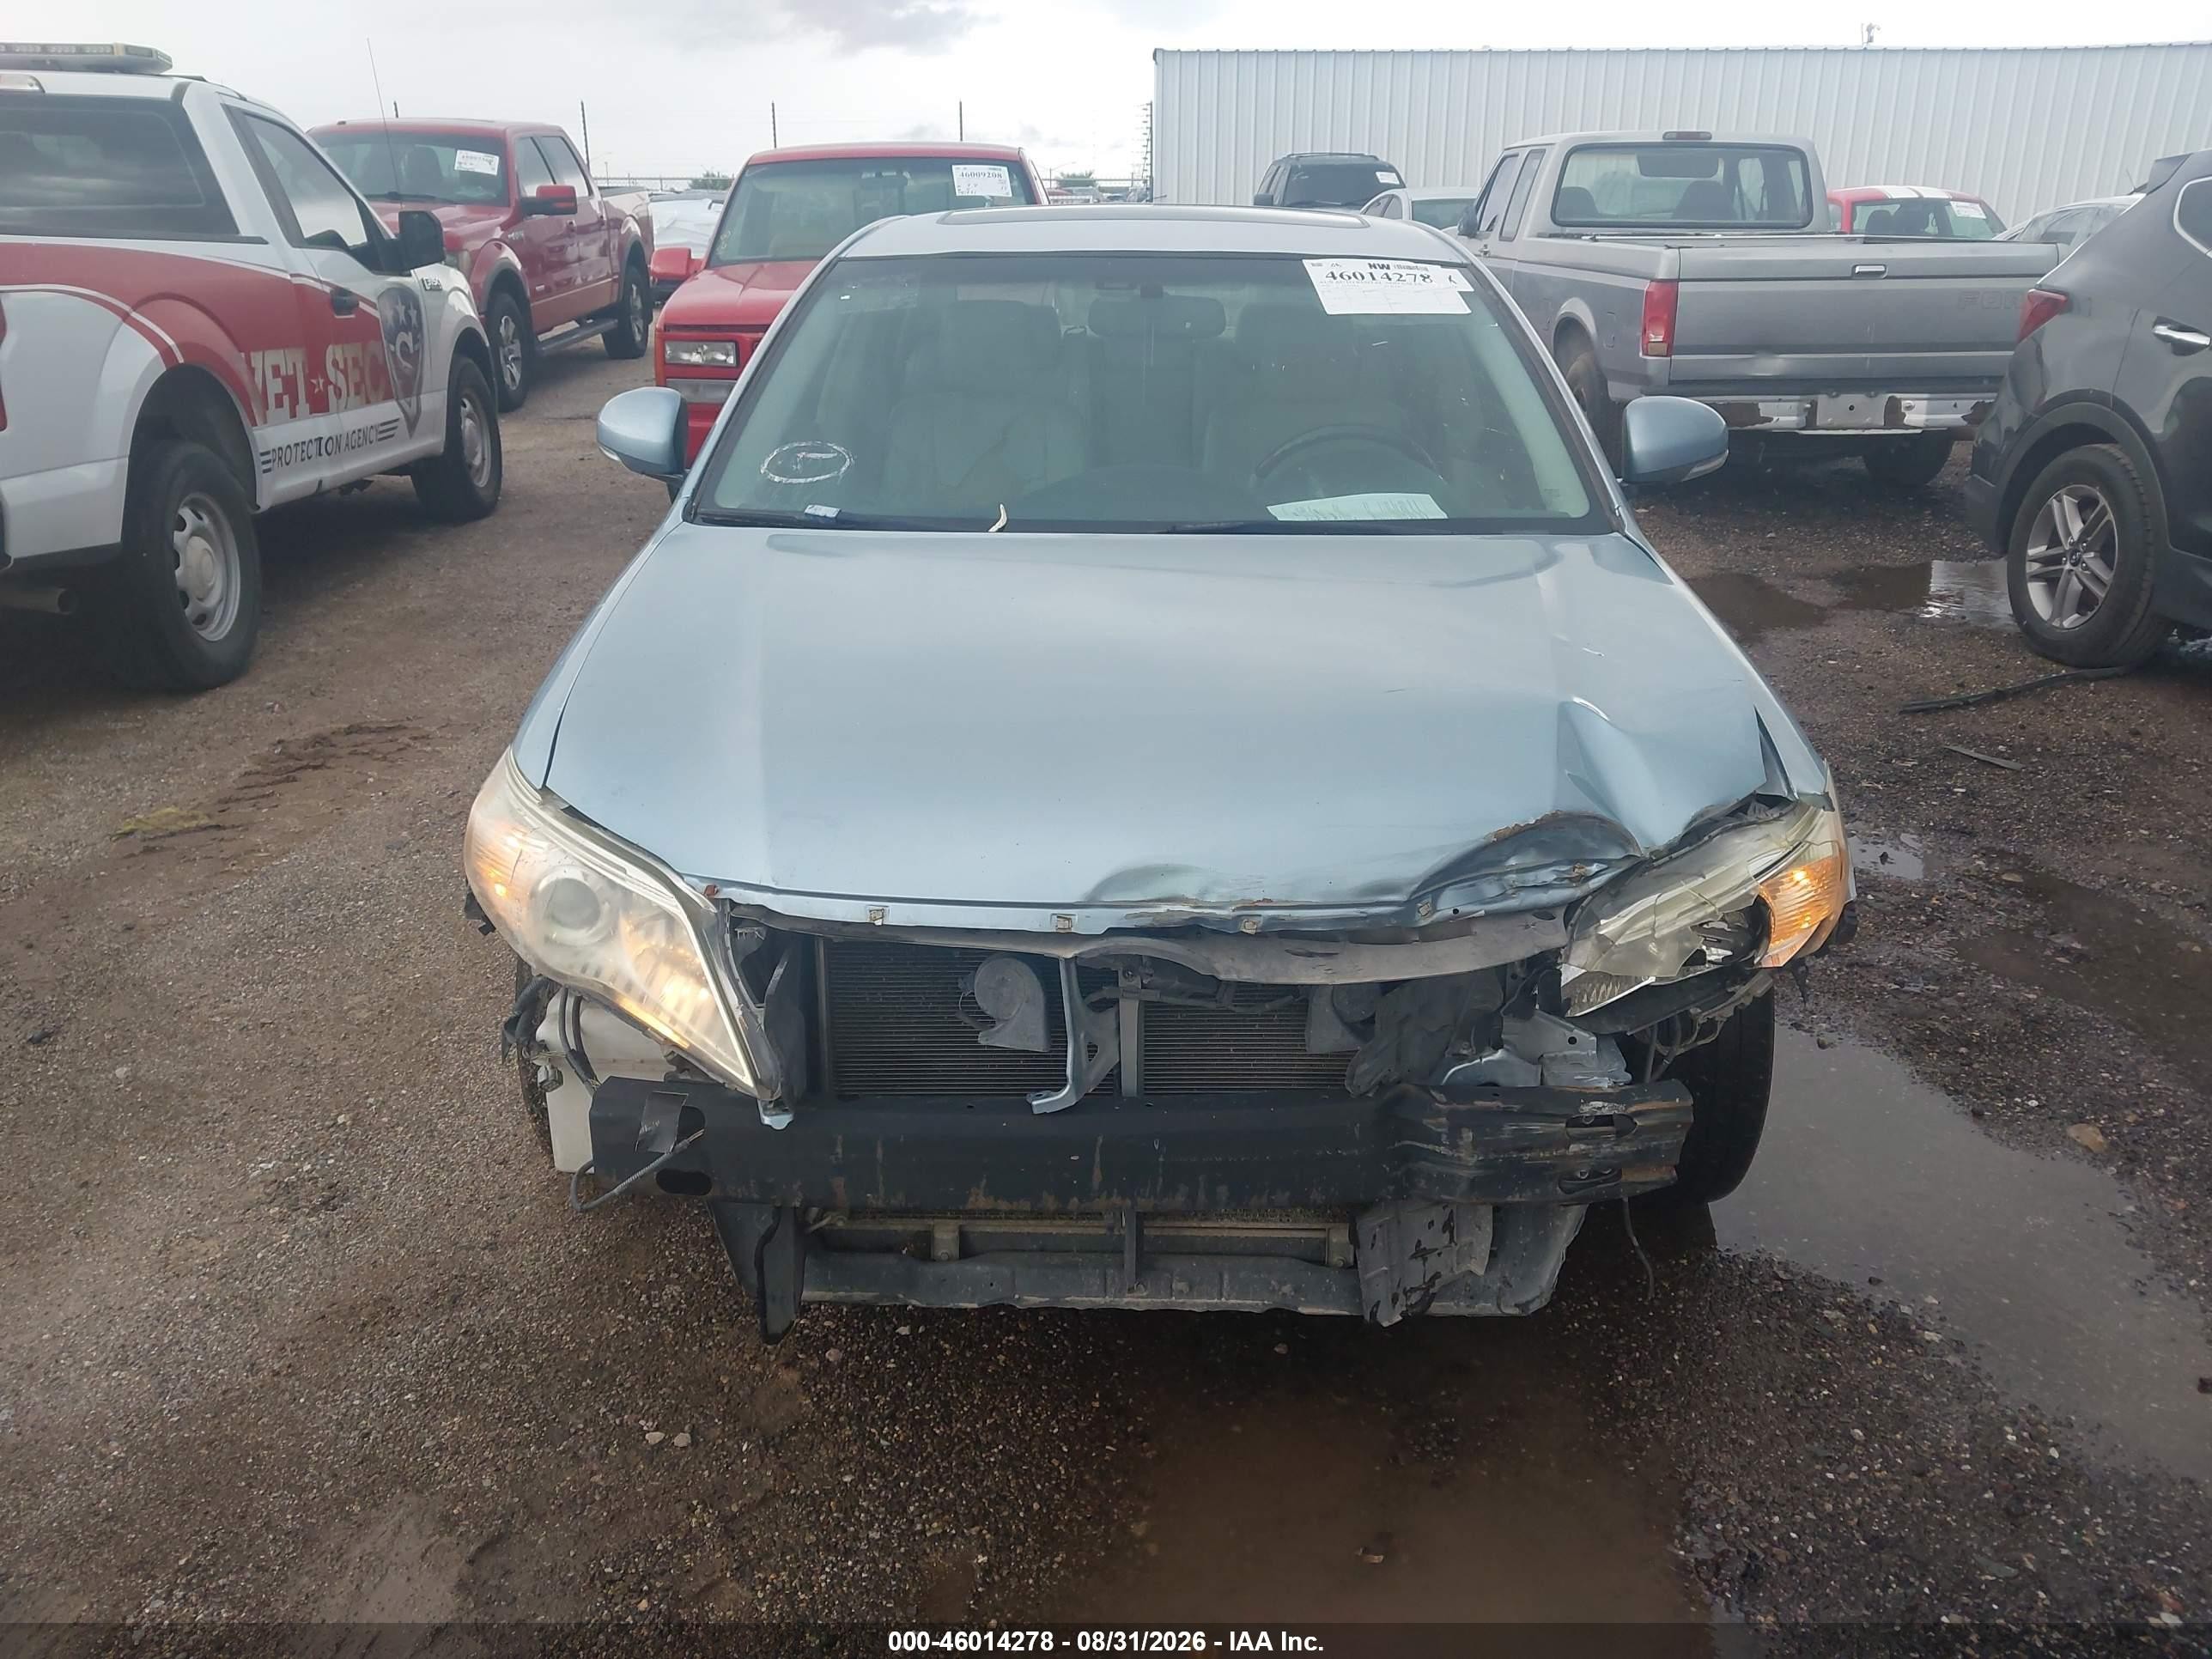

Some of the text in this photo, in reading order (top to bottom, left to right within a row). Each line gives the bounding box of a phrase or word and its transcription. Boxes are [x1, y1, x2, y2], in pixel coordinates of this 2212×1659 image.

[959, 171, 1003, 179] 46009208
[1367, 262, 1391, 270] NW
[1325, 270, 1433, 283] 46014278
[1957, 290, 2024, 310] FOR
[240, 340, 385, 427] VET SEC
[271, 425, 380, 468] PROTECTION AGENCY
